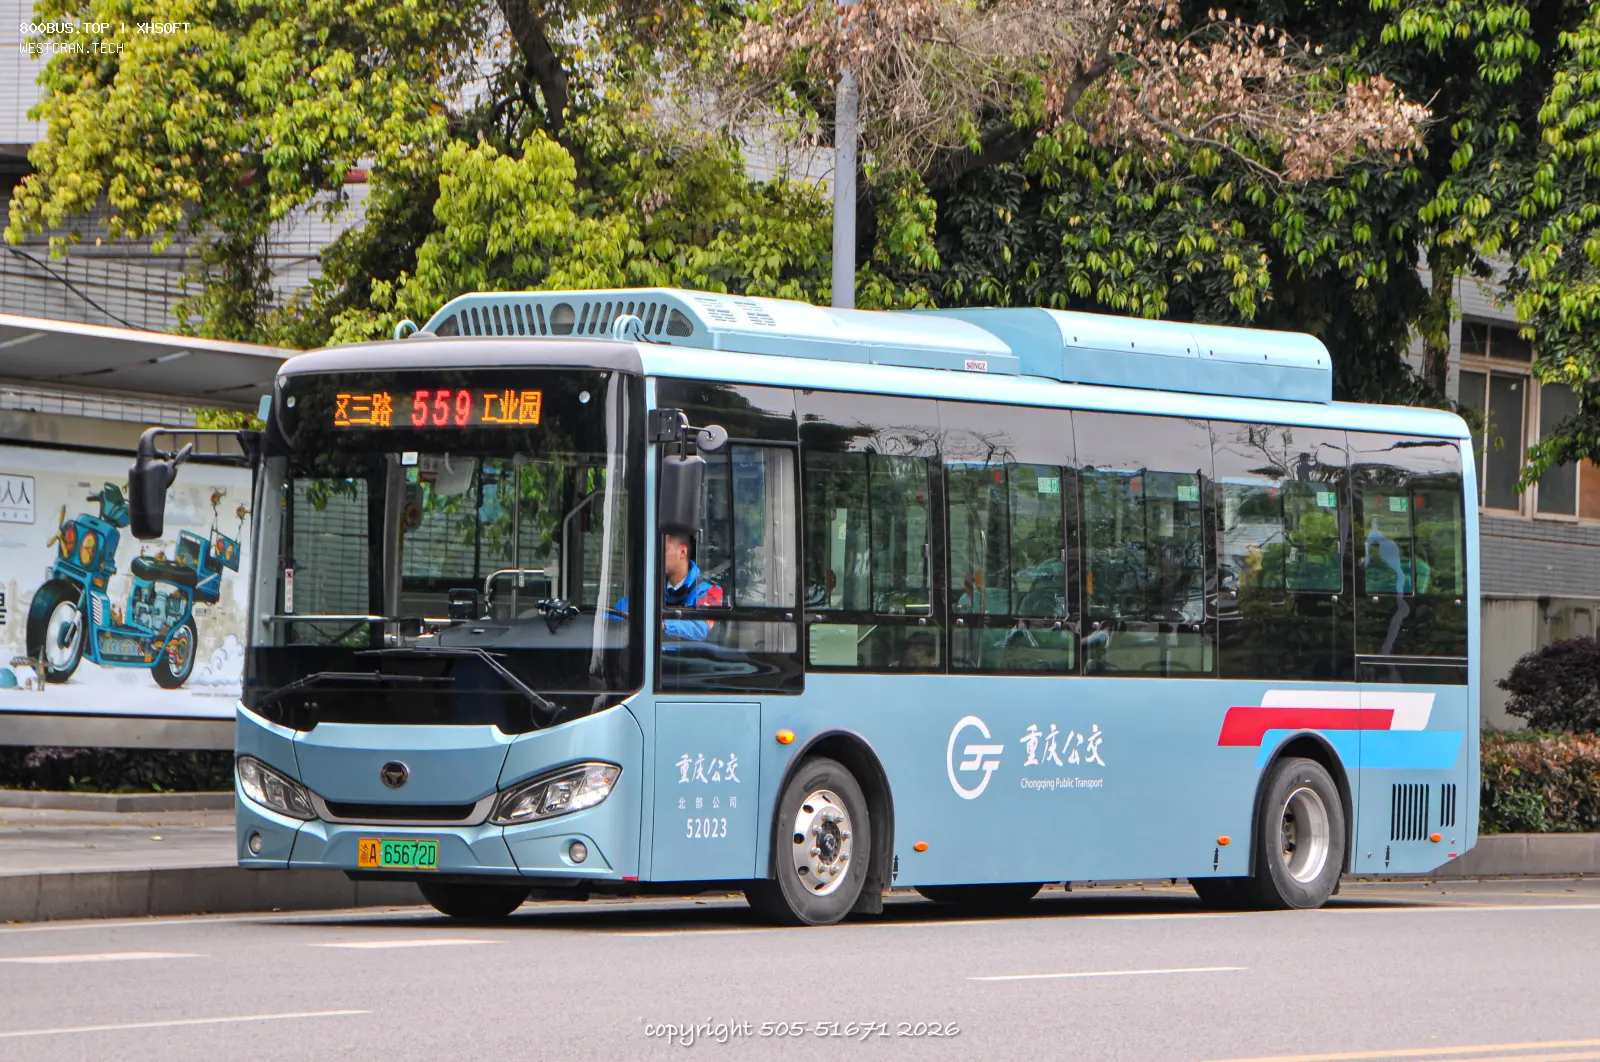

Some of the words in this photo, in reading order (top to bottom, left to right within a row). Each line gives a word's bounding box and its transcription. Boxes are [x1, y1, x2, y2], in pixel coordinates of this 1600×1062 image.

[334, 391, 394, 427] 区三路
[411, 389, 472, 427] 559
[481, 389, 543, 425] 工业园
[1019, 723, 1106, 767] 重庆公交
[675, 752, 741, 784] 重庆公交
[1020, 777, 1055, 791] Chongqing
[1055, 777, 1074, 788] Public
[1074, 777, 1103, 791] Transport
[678, 796, 737, 809] 北部公司
[686, 817, 727, 839] 52023
[384, 844, 436, 866] 65672D
